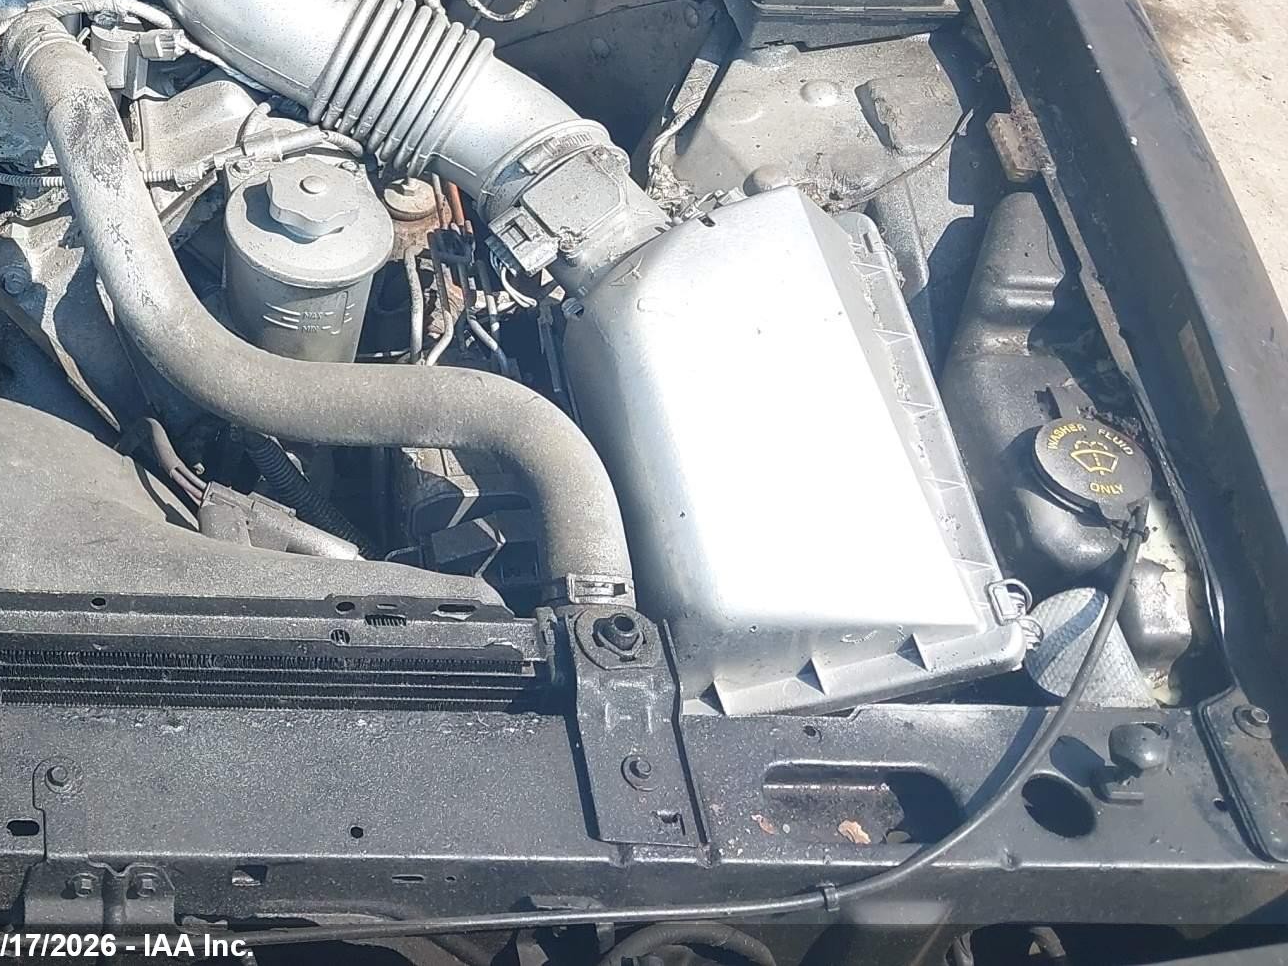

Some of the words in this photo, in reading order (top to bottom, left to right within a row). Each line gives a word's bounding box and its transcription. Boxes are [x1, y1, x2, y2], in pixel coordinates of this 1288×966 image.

[1047, 423, 1087, 450] WASHER
[1097, 428, 1134, 455] FLUID
[1089, 482, 1124, 495] ONLY
